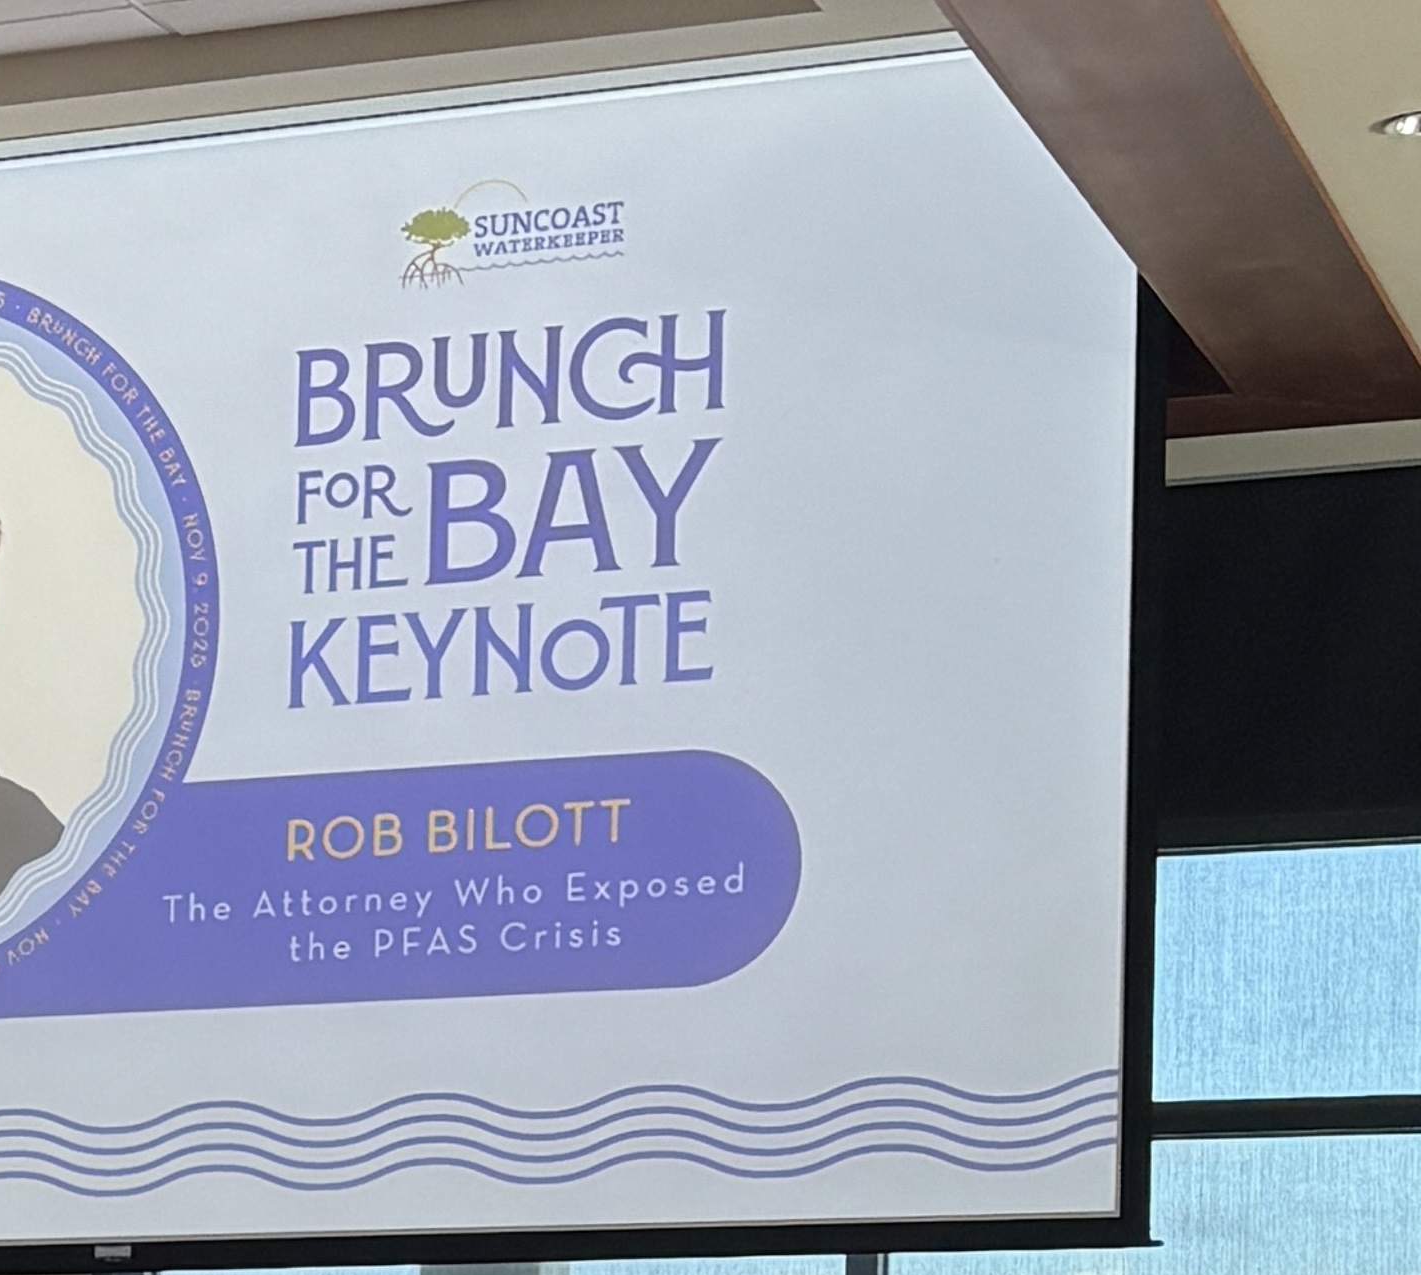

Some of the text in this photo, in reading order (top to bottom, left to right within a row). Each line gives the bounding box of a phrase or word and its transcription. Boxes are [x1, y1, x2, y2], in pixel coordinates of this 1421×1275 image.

[473, 201, 625, 239] SUNCOAST
[473, 228, 625, 258] WATERKEEPER
[294, 308, 727, 447] BRUNCH
[296, 464, 413, 525] FOR
[423, 437, 723, 586] BAY
[293, 534, 408, 594] THE
[287, 590, 714, 709] KEYNOTE
[286, 798, 631, 862] ROB BILOTT
[162, 862, 745, 924] The Attorney Who Exposed
[288, 919, 623, 963] the PFAS Crisis
